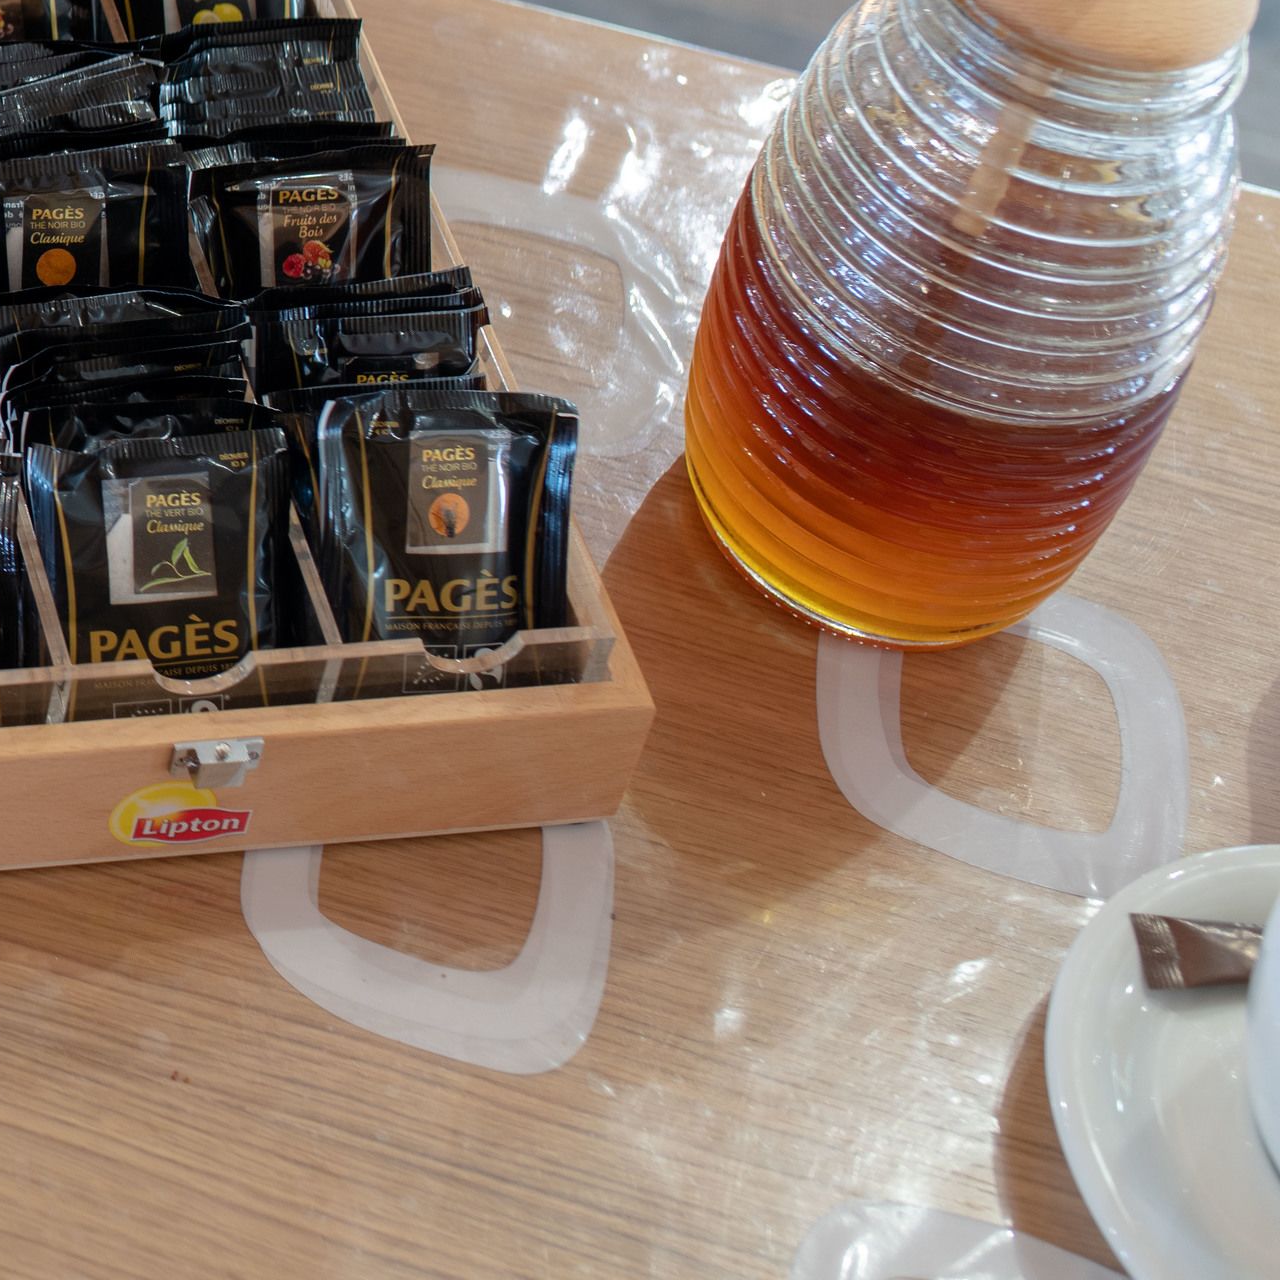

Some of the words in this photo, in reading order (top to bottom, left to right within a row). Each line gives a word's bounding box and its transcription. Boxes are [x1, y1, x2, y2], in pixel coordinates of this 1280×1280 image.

[32, 205, 85, 220] PAGÈS
[48, 221, 69, 229] NOIR
[71, 220, 86, 229] BIO
[284, 215, 316, 228] Fruits
[319, 214, 337, 224] des
[30, 231, 86, 246] Classique
[299, 226, 324, 239] Bois
[422, 445, 475, 461] PAGÈS
[440, 462, 460, 471] NOIR
[462, 462, 477, 470] BIO
[422, 475, 478, 490] Classique
[146, 489, 201, 507] PAGÈS
[164, 508, 184, 517] VERT
[186, 508, 204, 516] BIO
[147, 519, 205, 535] Classique
[384, 569, 518, 612] PAGÈS
[384, 623, 420, 632] MAISON
[90, 613, 239, 664] PAGÈS
[94, 680, 133, 690] MAISON
[184, 663, 217, 675] DEPUIS
[142, 817, 240, 838] Lipton
